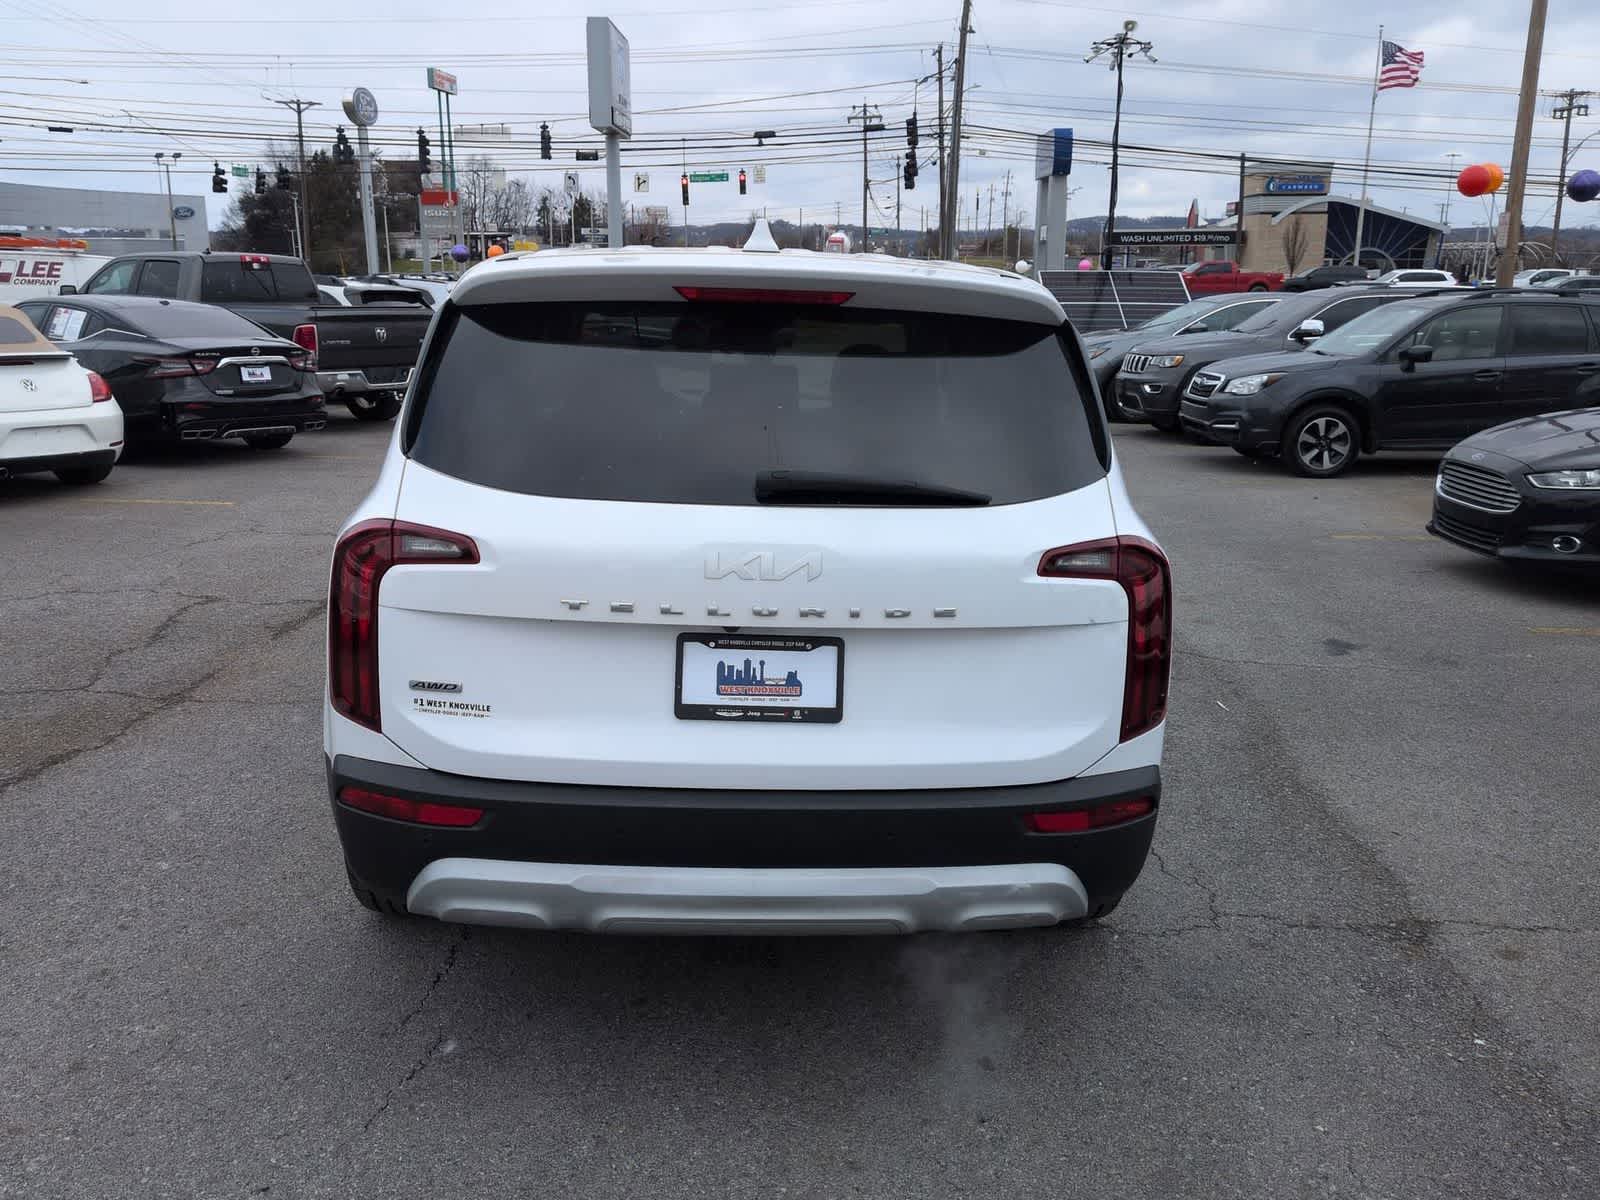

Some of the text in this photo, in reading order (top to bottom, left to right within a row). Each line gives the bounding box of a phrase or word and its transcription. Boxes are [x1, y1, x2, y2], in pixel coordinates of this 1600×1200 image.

[1147, 234, 1191, 242] UNLIMITED
[16, 261, 64, 278] LEE
[14, 278, 60, 286] COMPANY
[704, 551, 823, 583] KIA
[560, 599, 957, 619] TELLURIDE
[412, 681, 458, 691] AWD
[719, 685, 801, 696] WEST KNOXVILLE
[413, 698, 492, 712] #1 WEST KNOXVILLE
